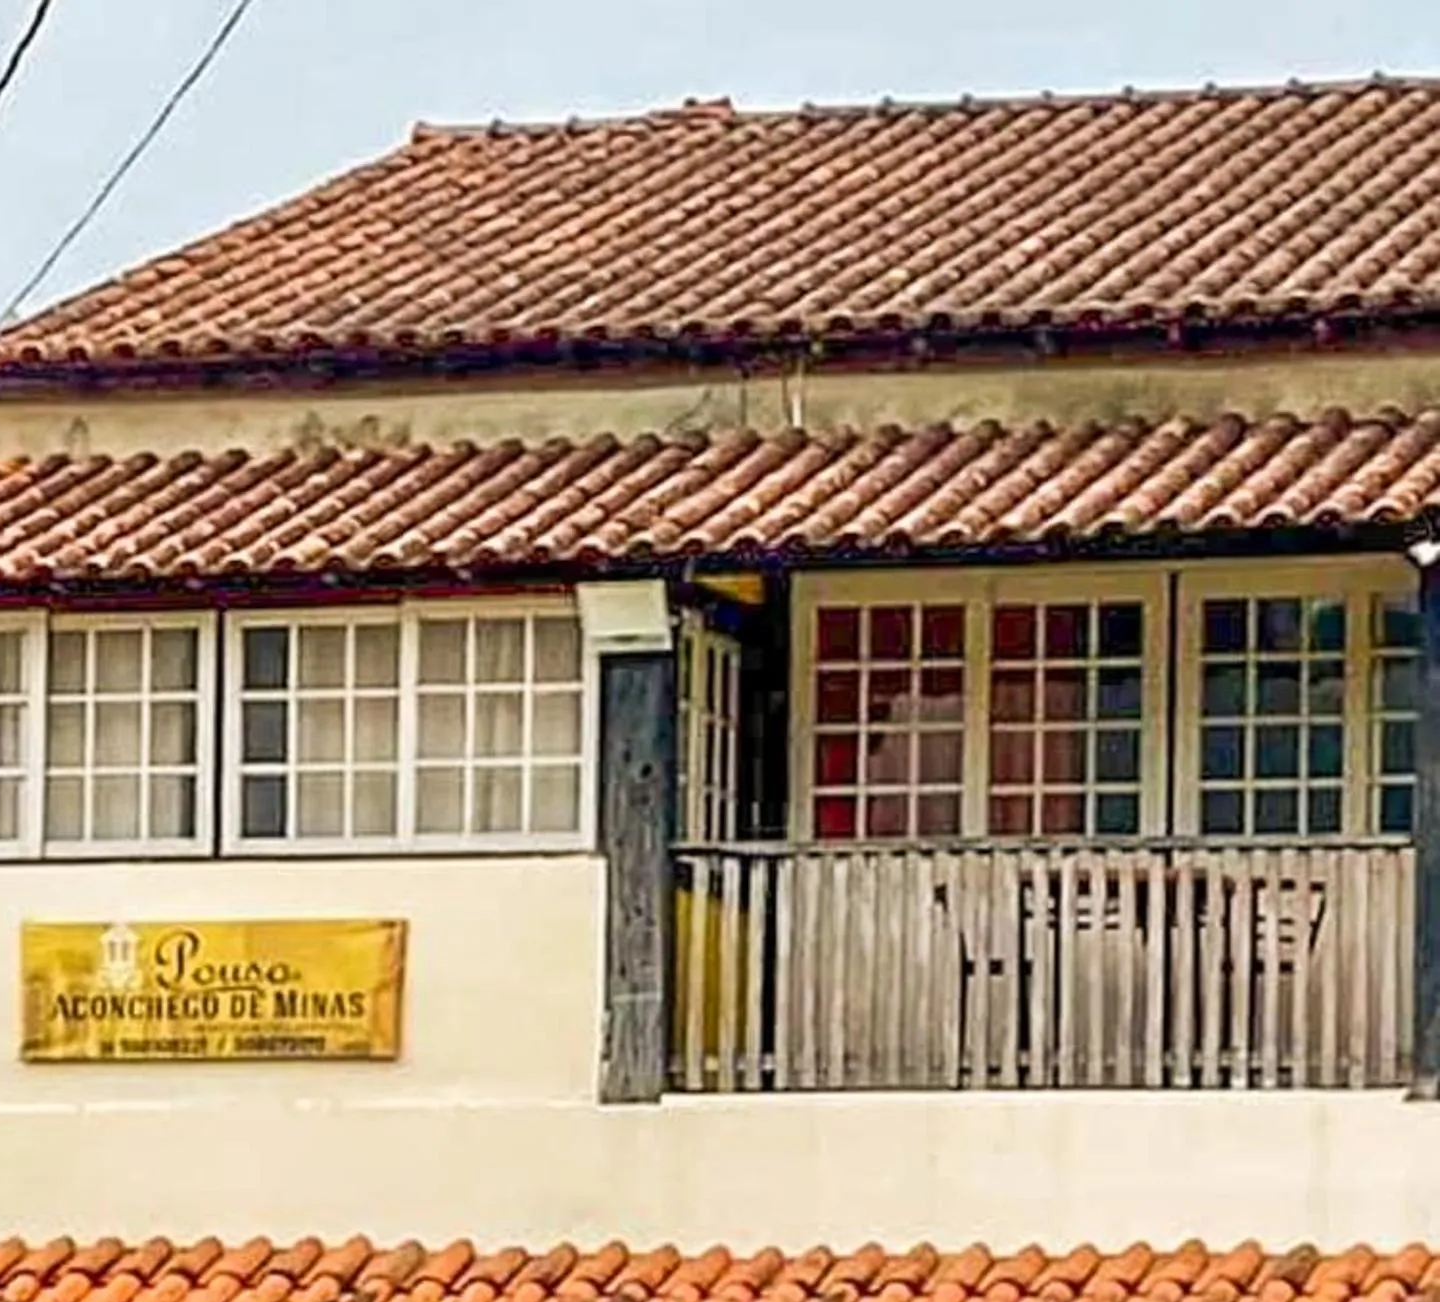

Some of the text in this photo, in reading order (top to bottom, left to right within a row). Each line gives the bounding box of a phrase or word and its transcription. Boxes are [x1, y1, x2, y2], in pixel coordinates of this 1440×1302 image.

[154, 927, 291, 990] Pouso
[230, 990, 262, 1020] DE
[273, 989, 366, 1020] MINAS
